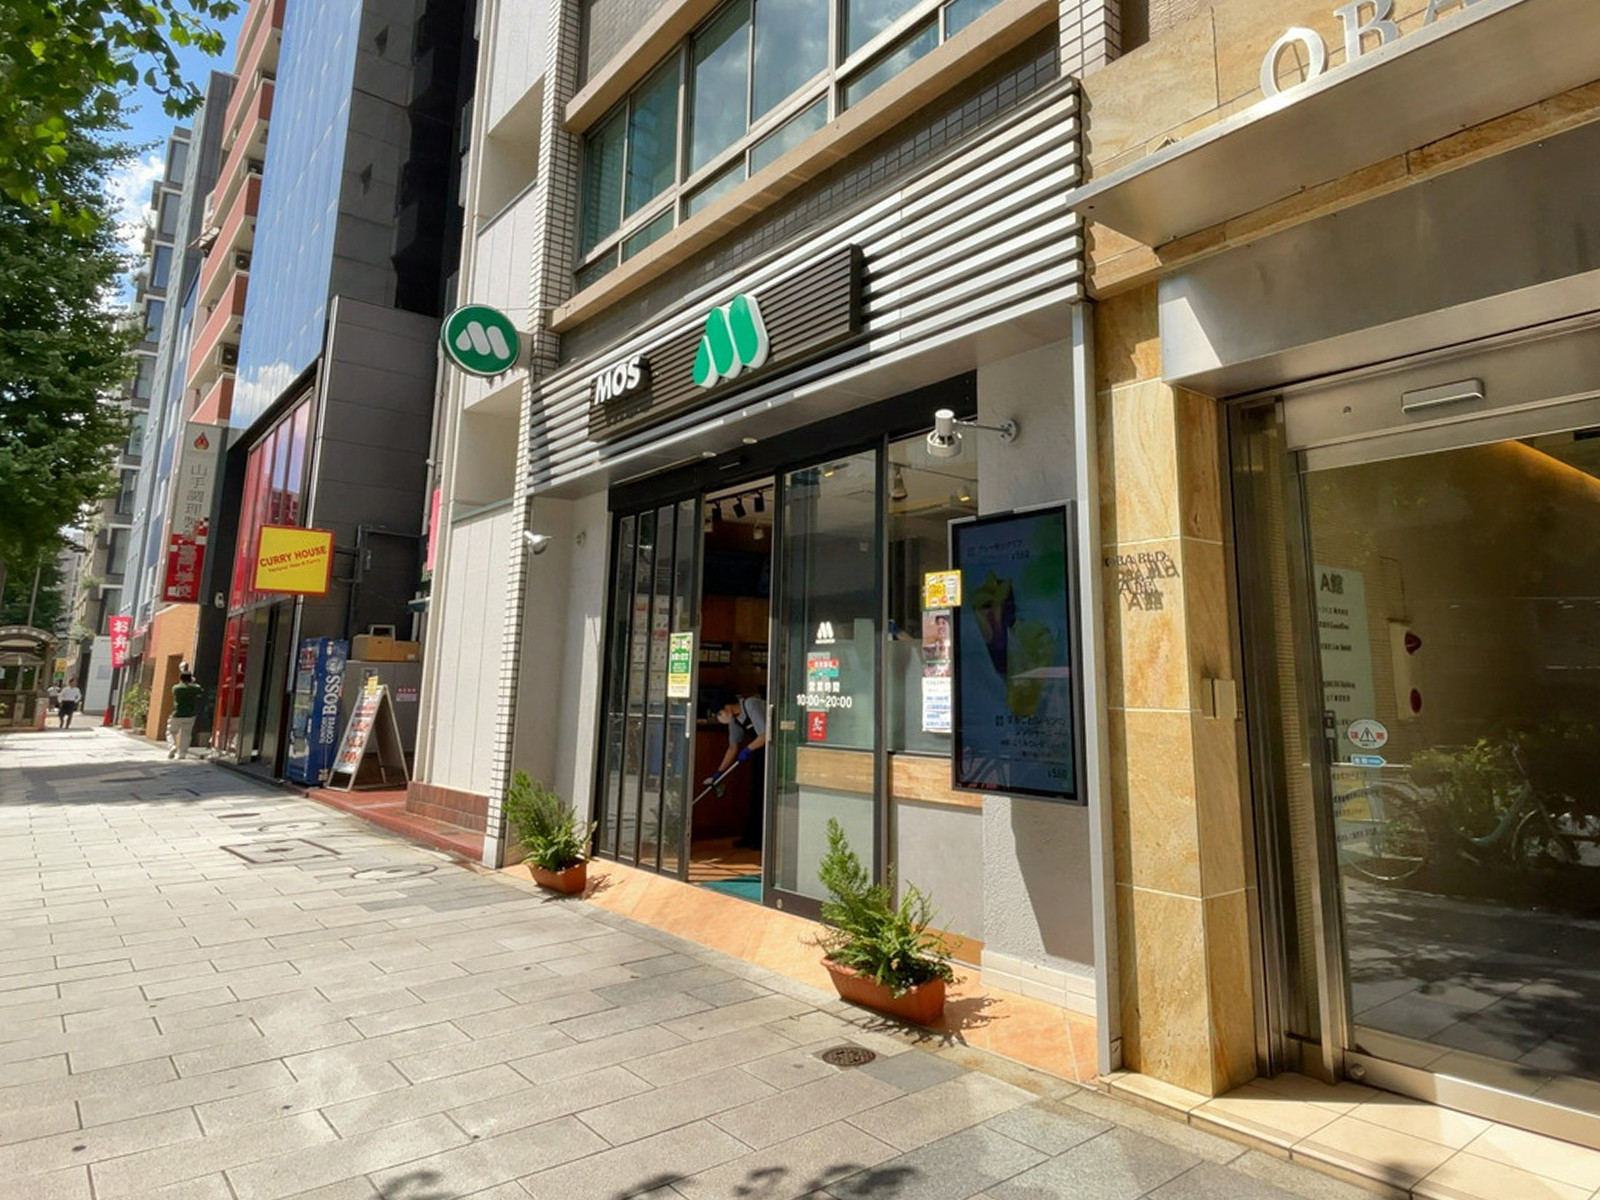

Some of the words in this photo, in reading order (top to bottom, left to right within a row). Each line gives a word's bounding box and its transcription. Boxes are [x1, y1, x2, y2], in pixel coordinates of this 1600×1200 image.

[594, 354, 641, 406] MOS
[260, 553, 291, 567] CURRY
[295, 546, 327, 559] HOUSE
[113, 620, 129, 664] お弁当
[322, 675, 341, 716] BOSS
